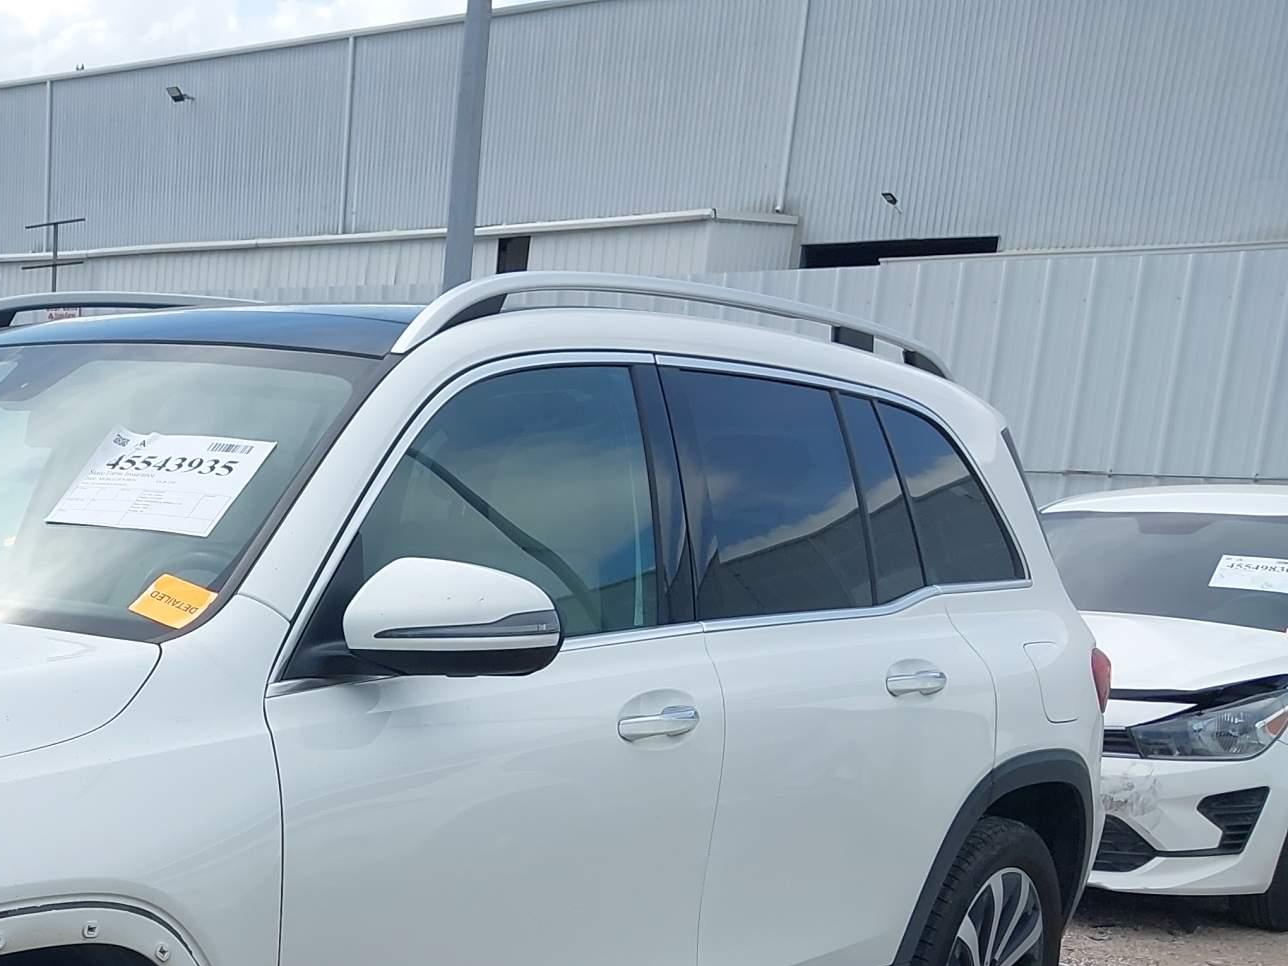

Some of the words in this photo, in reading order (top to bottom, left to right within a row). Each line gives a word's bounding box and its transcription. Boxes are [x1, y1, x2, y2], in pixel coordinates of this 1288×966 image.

[106, 454, 240, 477] 45543935
[1226, 562, 1288, 574] 4554983
[150, 590, 199, 615] DETAILED
